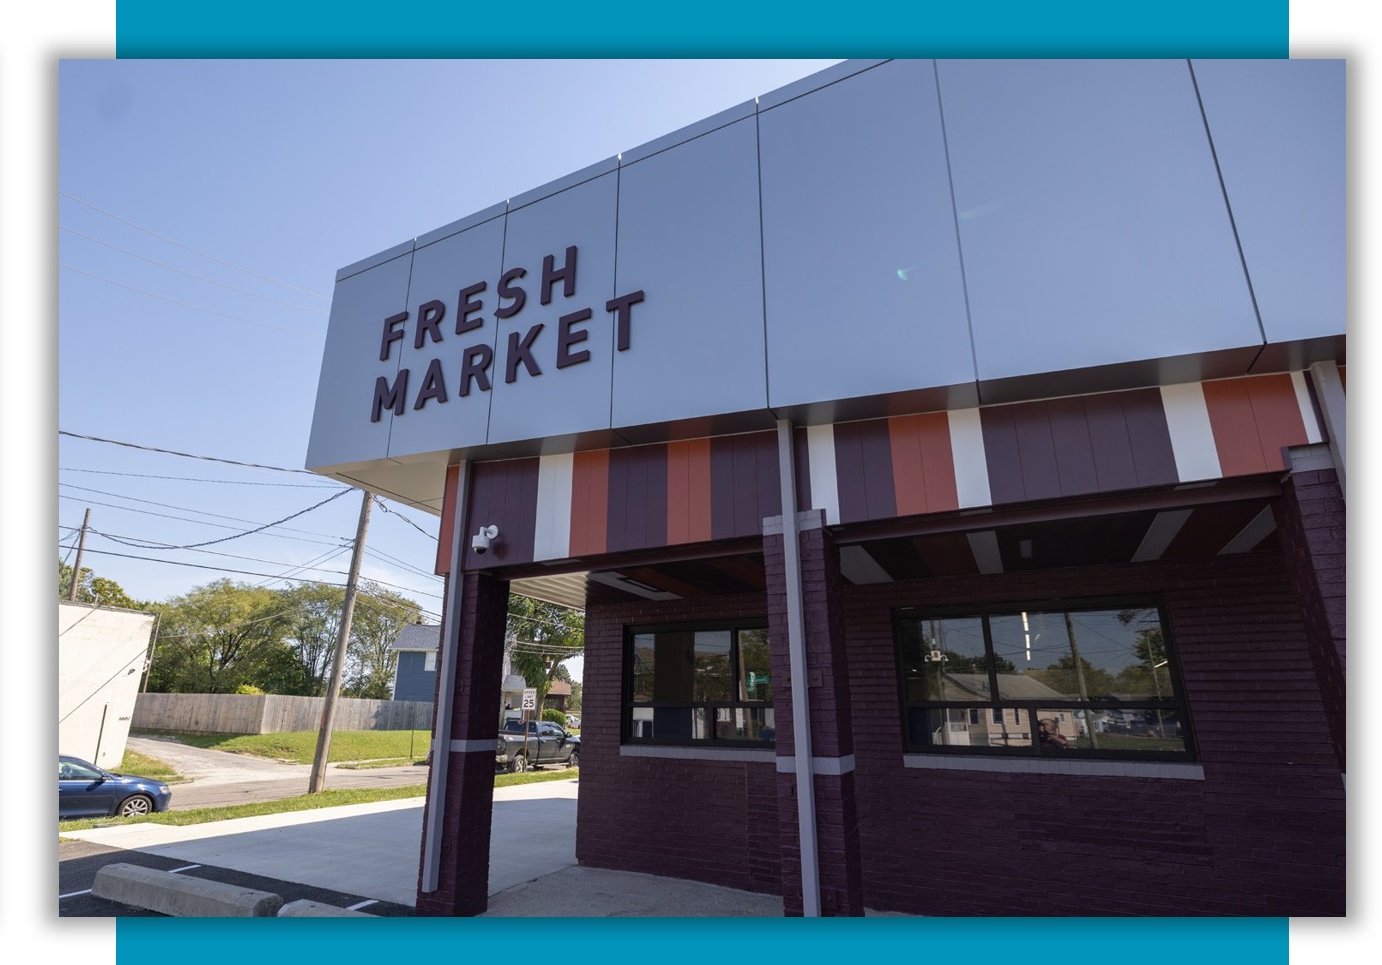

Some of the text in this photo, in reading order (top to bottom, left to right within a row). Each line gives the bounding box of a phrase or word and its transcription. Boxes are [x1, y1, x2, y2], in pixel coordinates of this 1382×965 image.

[370, 290, 644, 423] MARKET
[379, 245, 578, 361] FRESH
[524, 699, 534, 707] 25
